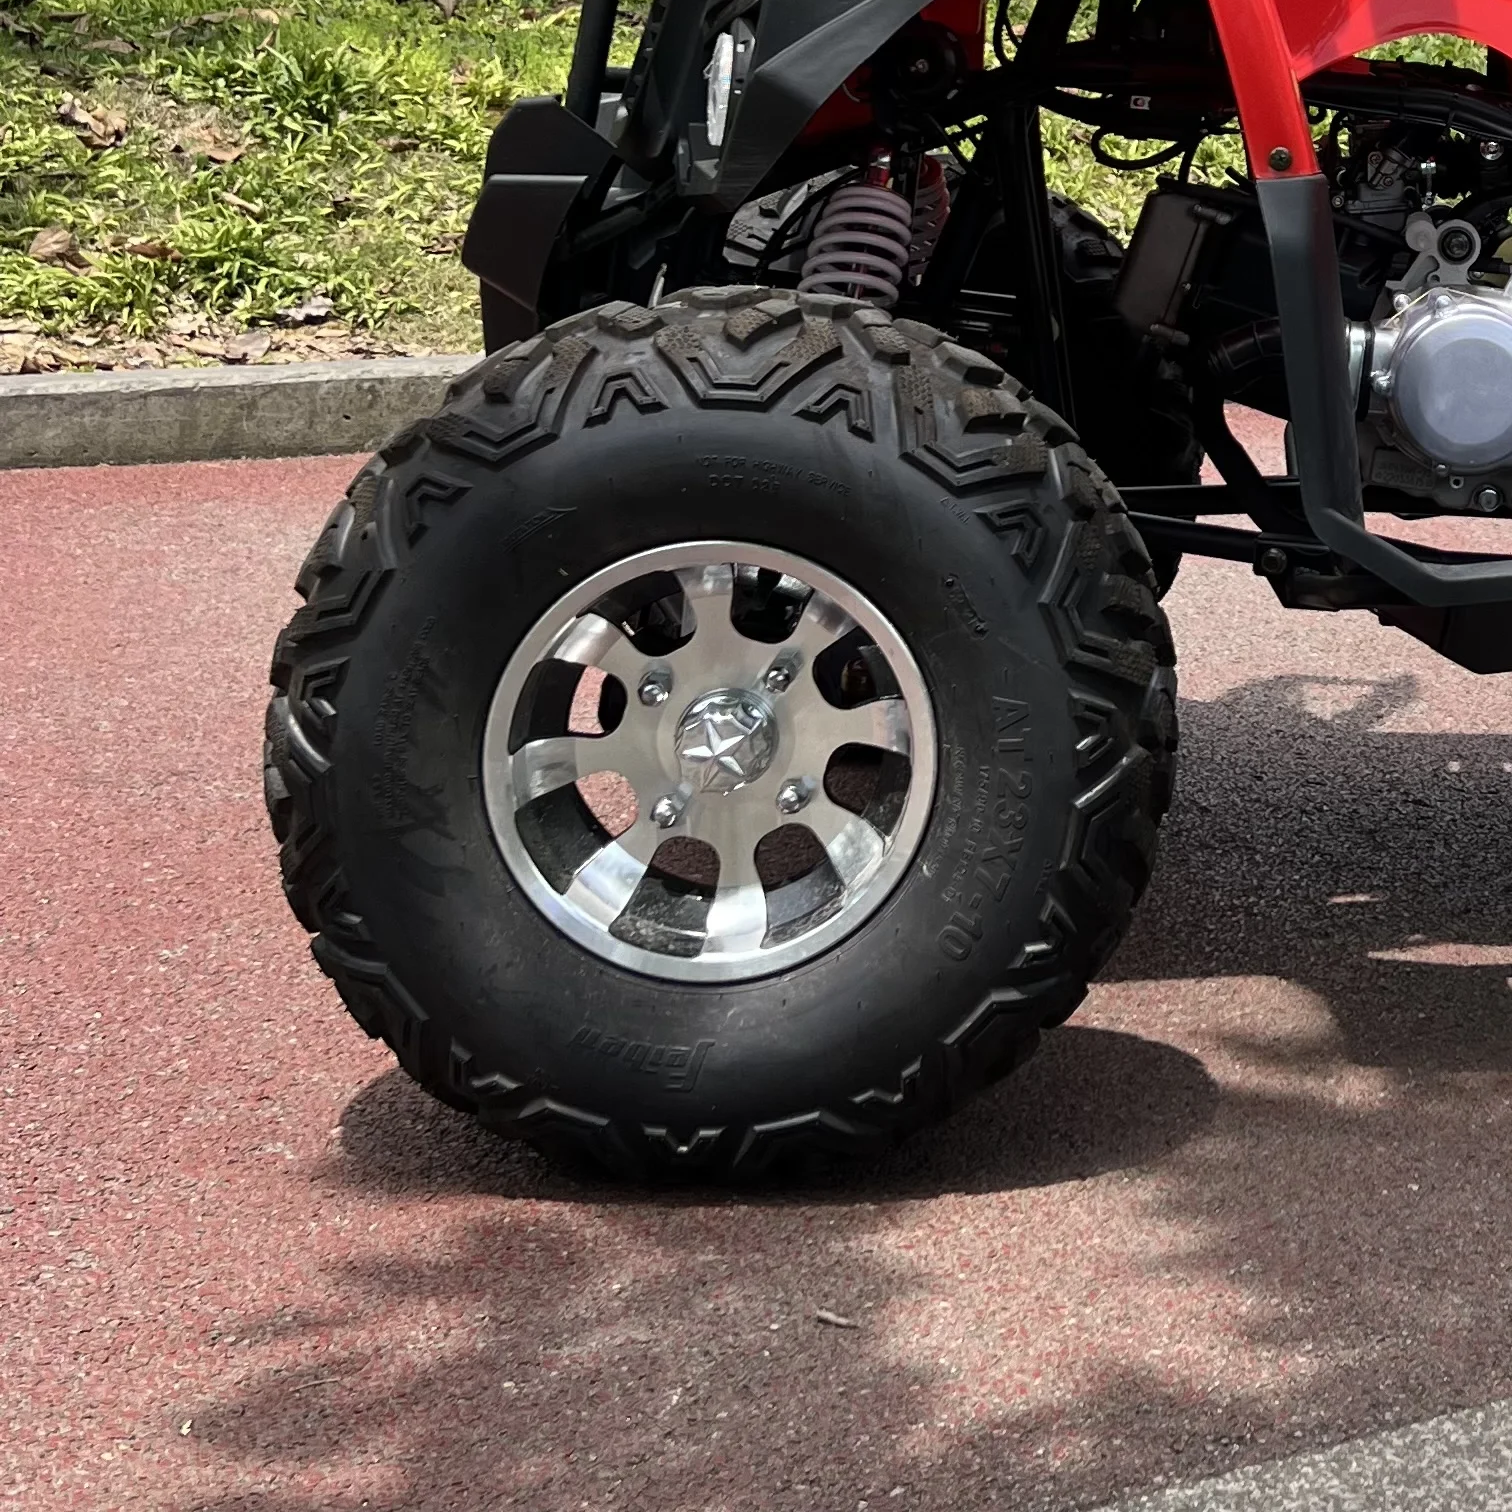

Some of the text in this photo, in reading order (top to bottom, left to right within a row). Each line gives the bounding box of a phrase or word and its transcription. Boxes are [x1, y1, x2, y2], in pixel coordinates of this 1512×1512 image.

[723, 454, 746, 468] FOR
[752, 459, 803, 479] HIGHWAY
[806, 471, 852, 497] SERVICE
[992, 694, 1033, 763] AT
[935, 768, 1034, 962] 23X7-10
